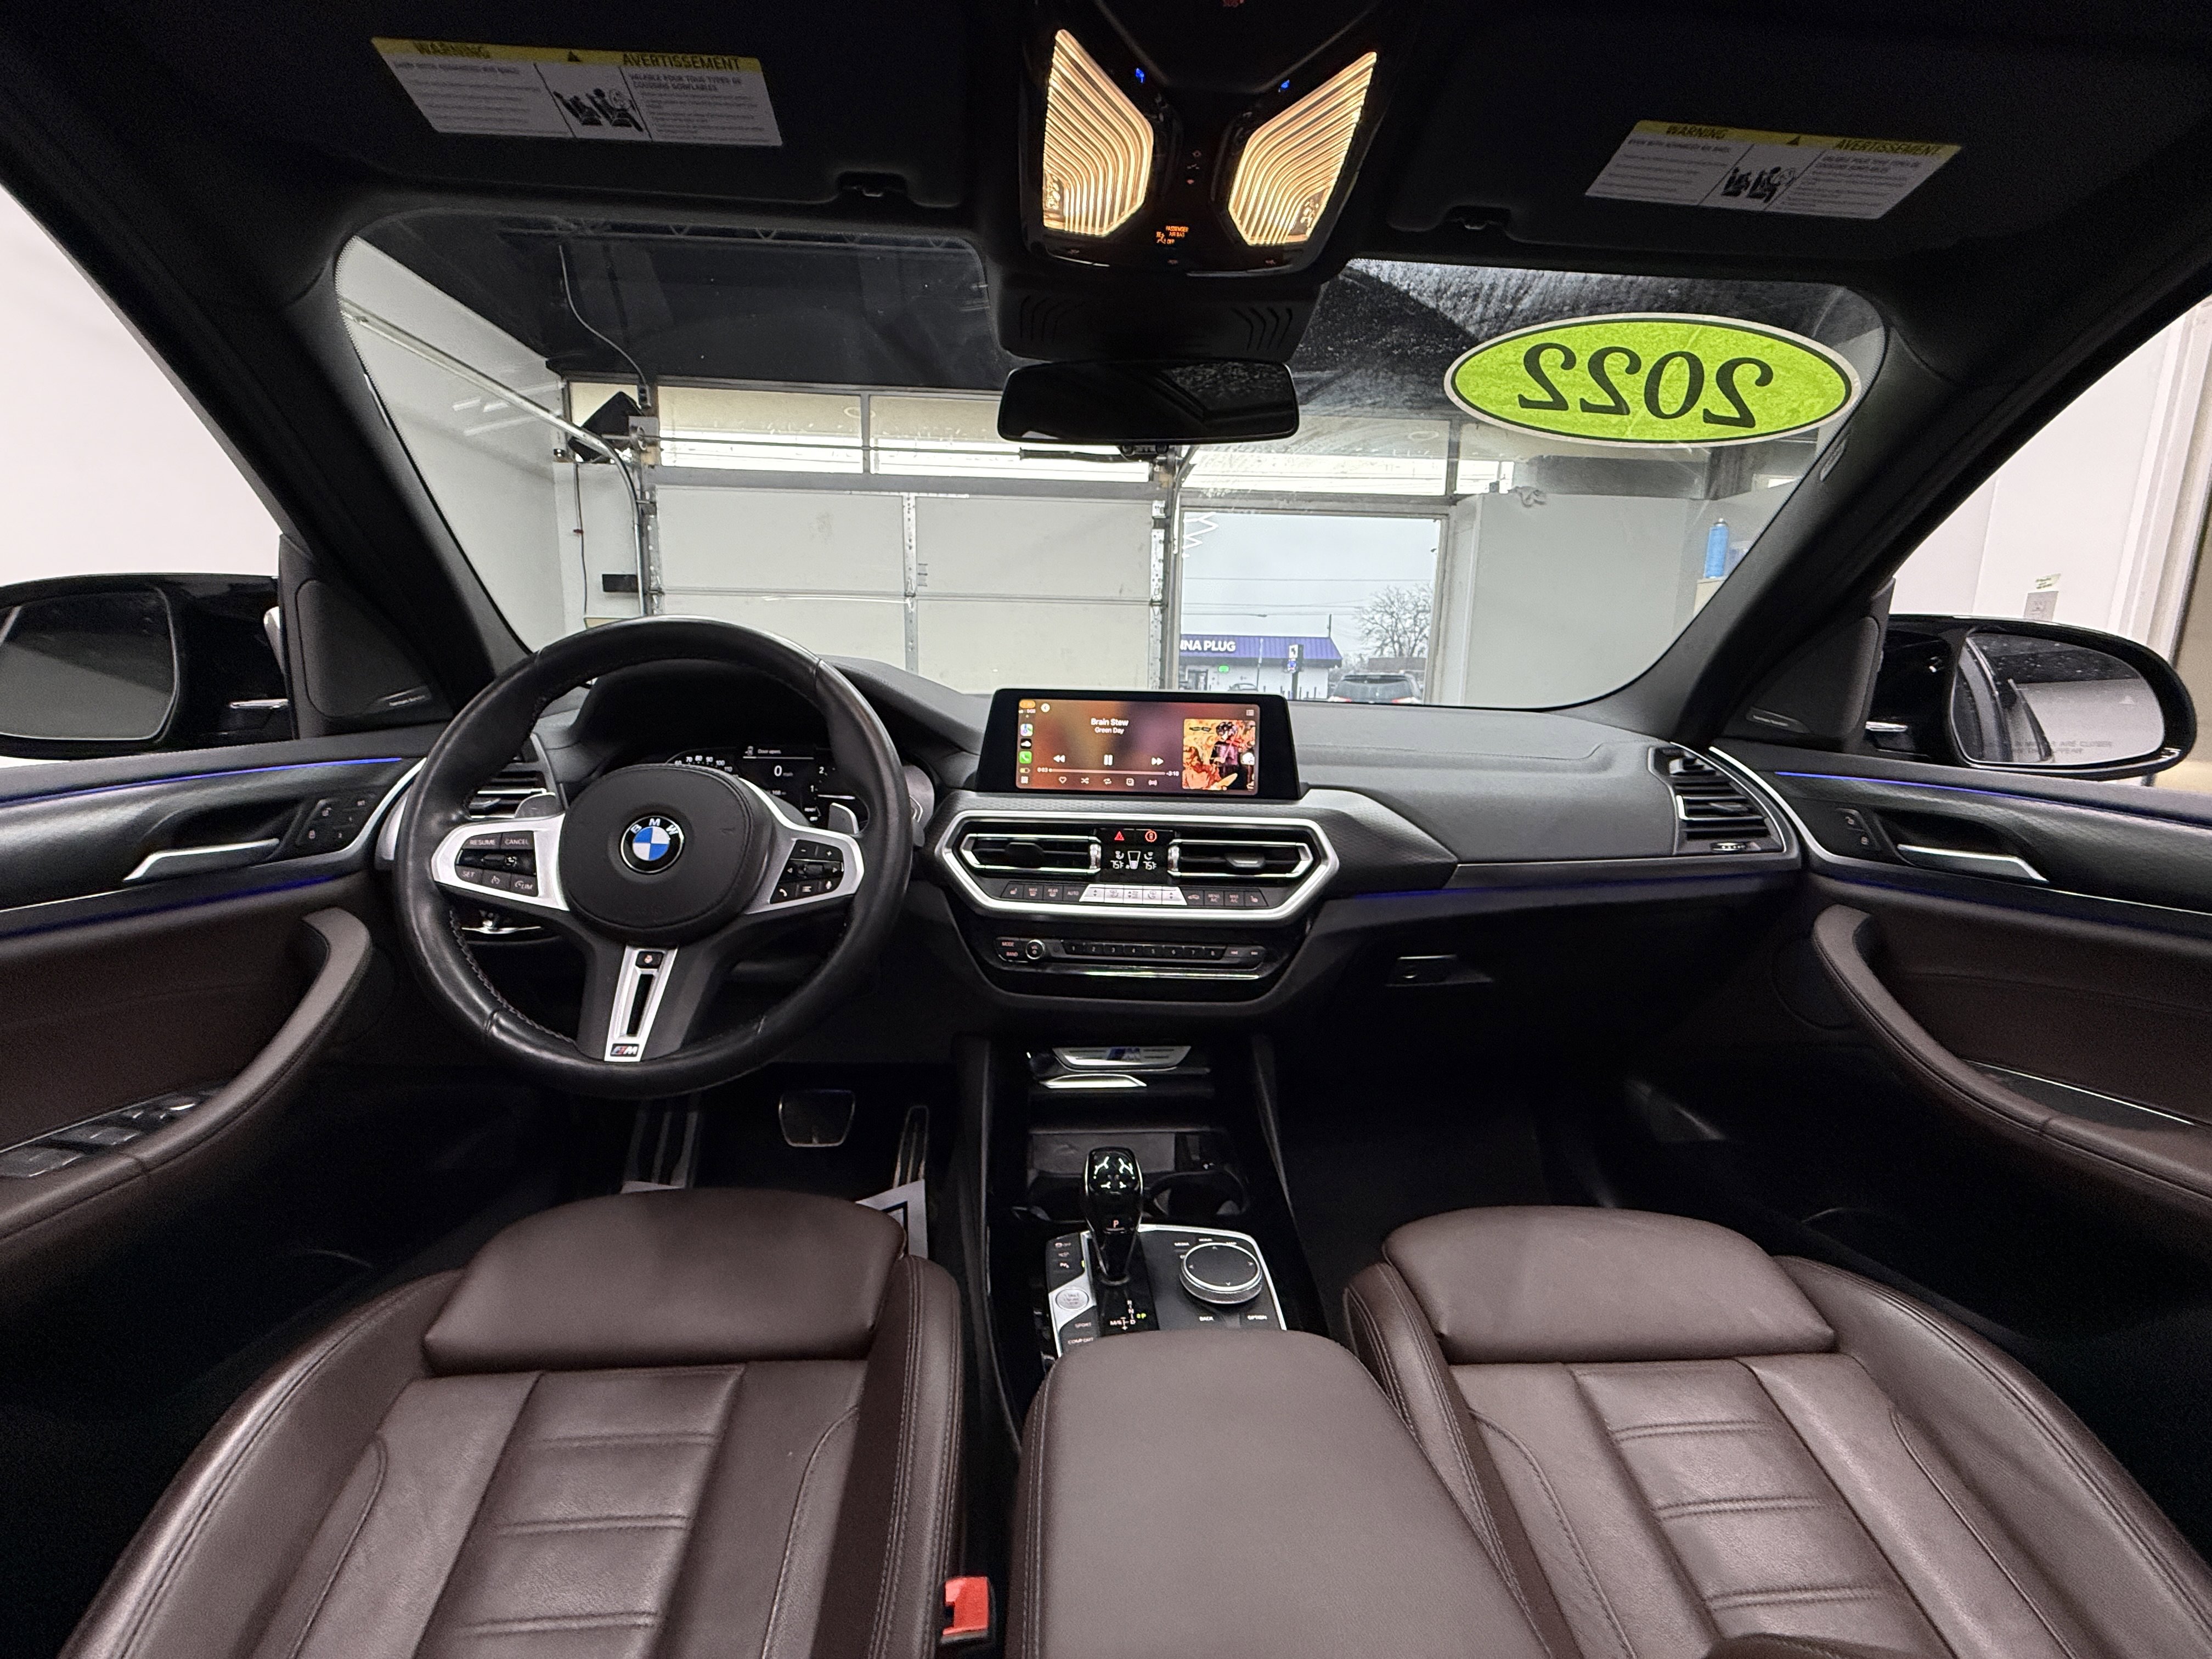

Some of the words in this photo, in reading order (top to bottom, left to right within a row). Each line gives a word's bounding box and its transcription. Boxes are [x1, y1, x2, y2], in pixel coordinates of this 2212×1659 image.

[622, 53, 741, 70] AVERTISSEMENT
[1834, 138, 1942, 156] AVERTISSEMENT
[1204, 640, 1235, 652] PLUG
[1091, 718, 1109, 726] Brain
[1110, 719, 1129, 727] Stew
[774, 765, 782, 777] 0
[819, 766, 825, 774] 2
[810, 785, 814, 793] 1
[630, 818, 679, 835] BMW
[1113, 1220, 1120, 1228] P
